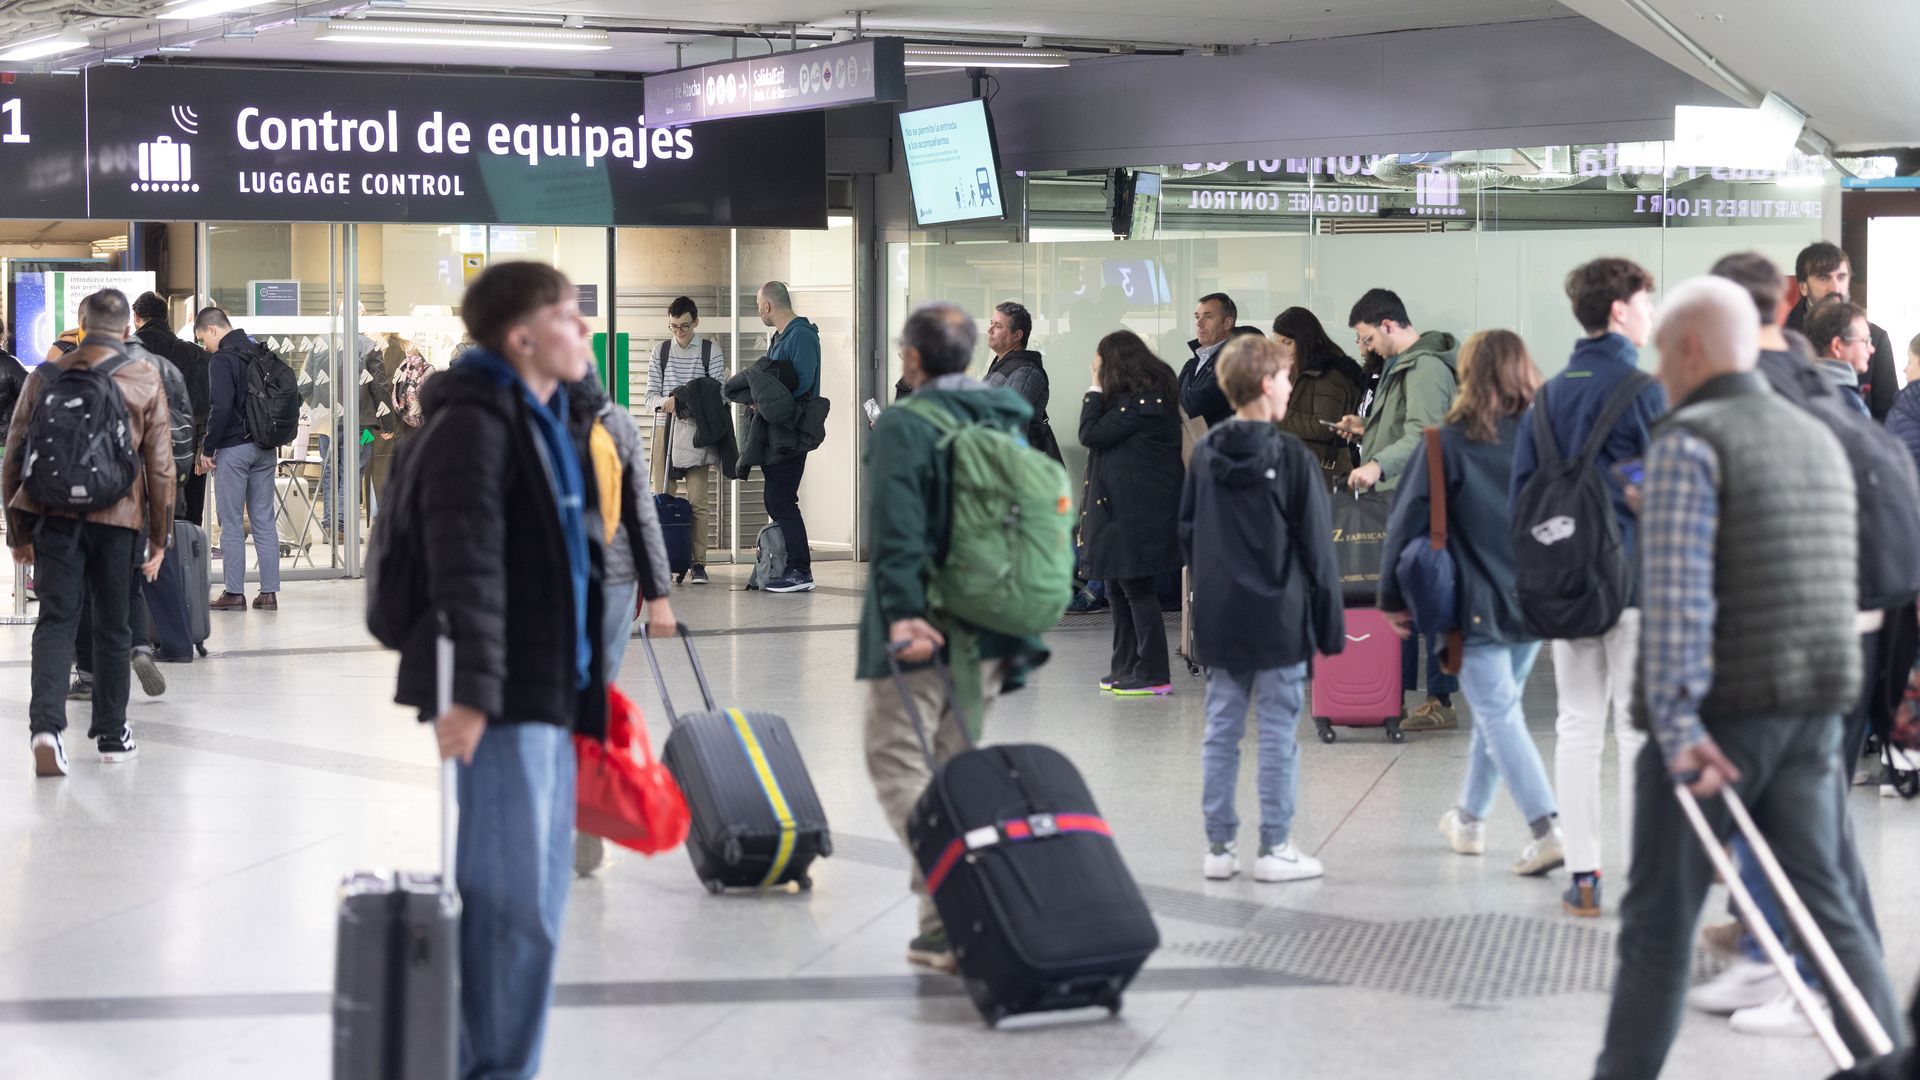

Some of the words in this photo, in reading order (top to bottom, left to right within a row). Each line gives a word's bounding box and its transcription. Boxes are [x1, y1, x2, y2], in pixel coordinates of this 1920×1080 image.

[2, 98, 31, 143] 1
[236, 106, 398, 153] Control
[417, 111, 471, 154] de
[487, 112, 694, 169] equipajes
[918, 124, 934, 137] permite
[940, 121, 958, 132] entrada
[239, 171, 350, 195] LUGGAGE
[361, 173, 465, 196] CONTROL
